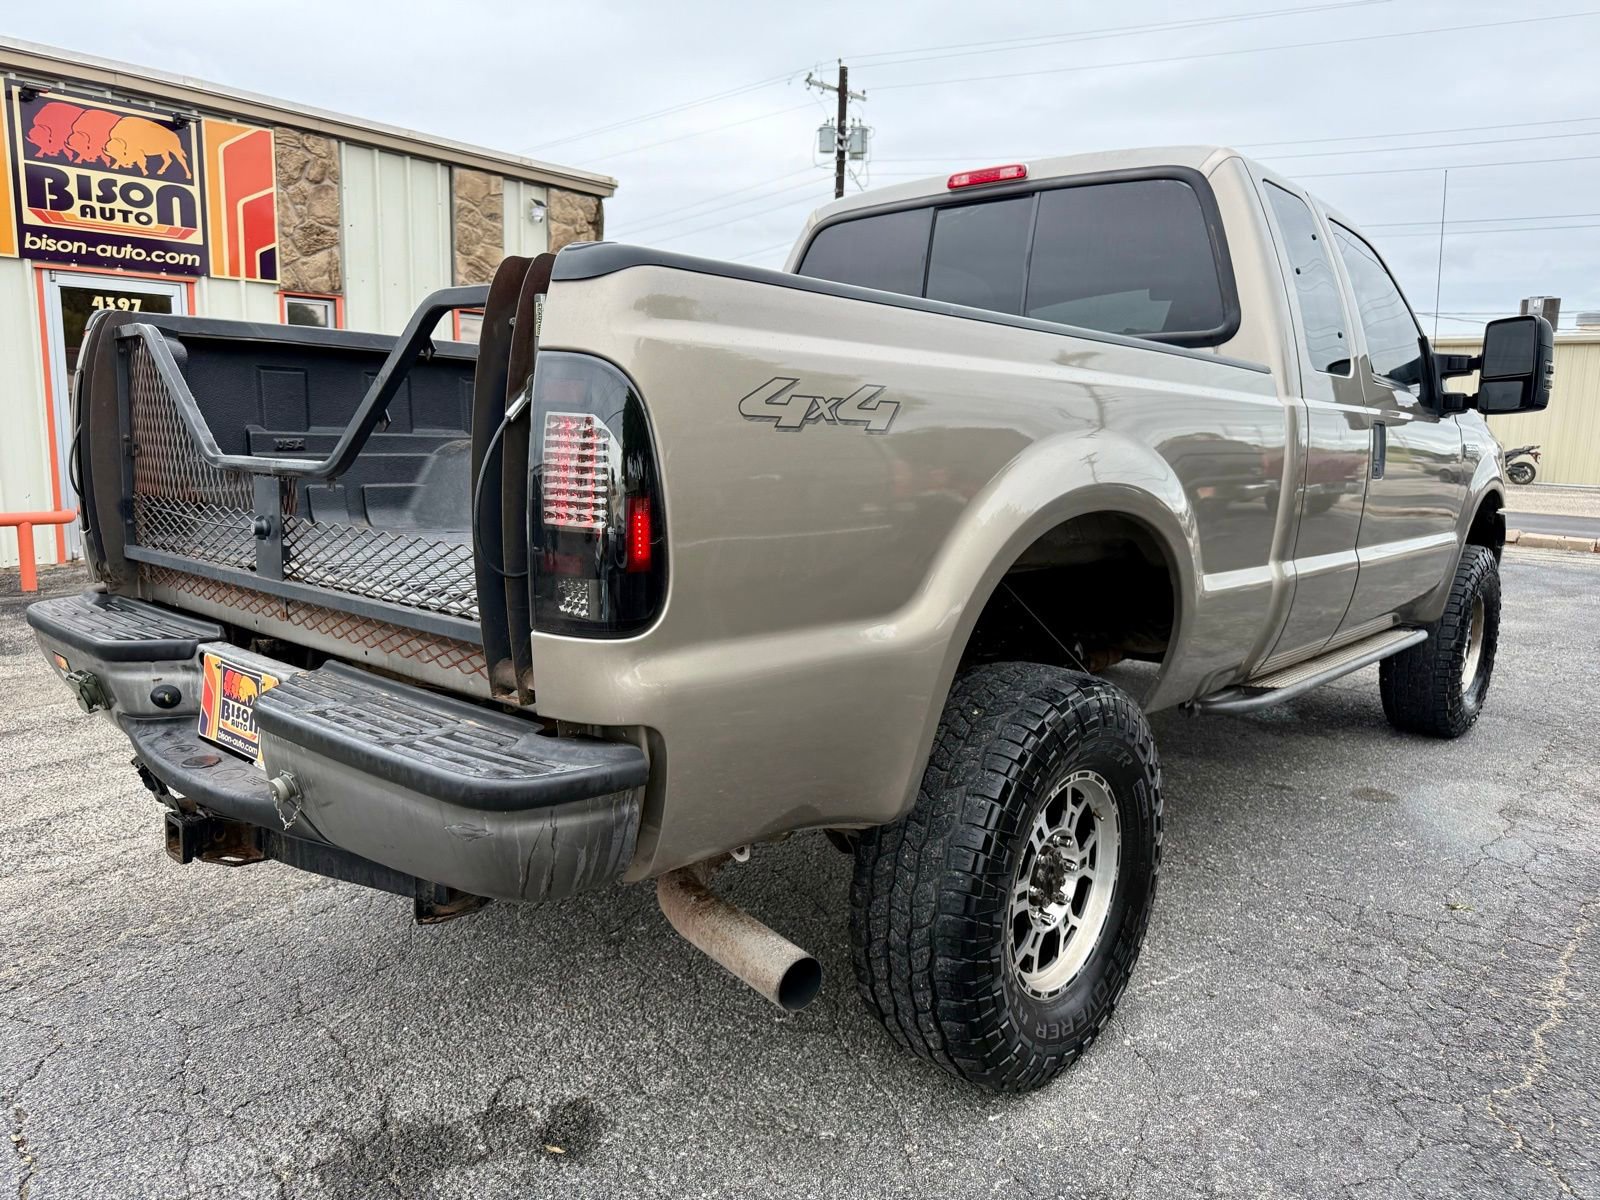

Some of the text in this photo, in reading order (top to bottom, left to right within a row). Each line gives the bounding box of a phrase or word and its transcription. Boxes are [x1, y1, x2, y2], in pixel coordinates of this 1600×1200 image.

[25, 163, 197, 228] BISON
[79, 203, 153, 226] AUTO
[24, 232, 200, 267] bison-auto.com
[91, 295, 142, 313] 4397
[739, 376, 901, 435] 4x4
[231, 718, 248, 732] AUTO
[218, 729, 258, 755] bison-auto.com
